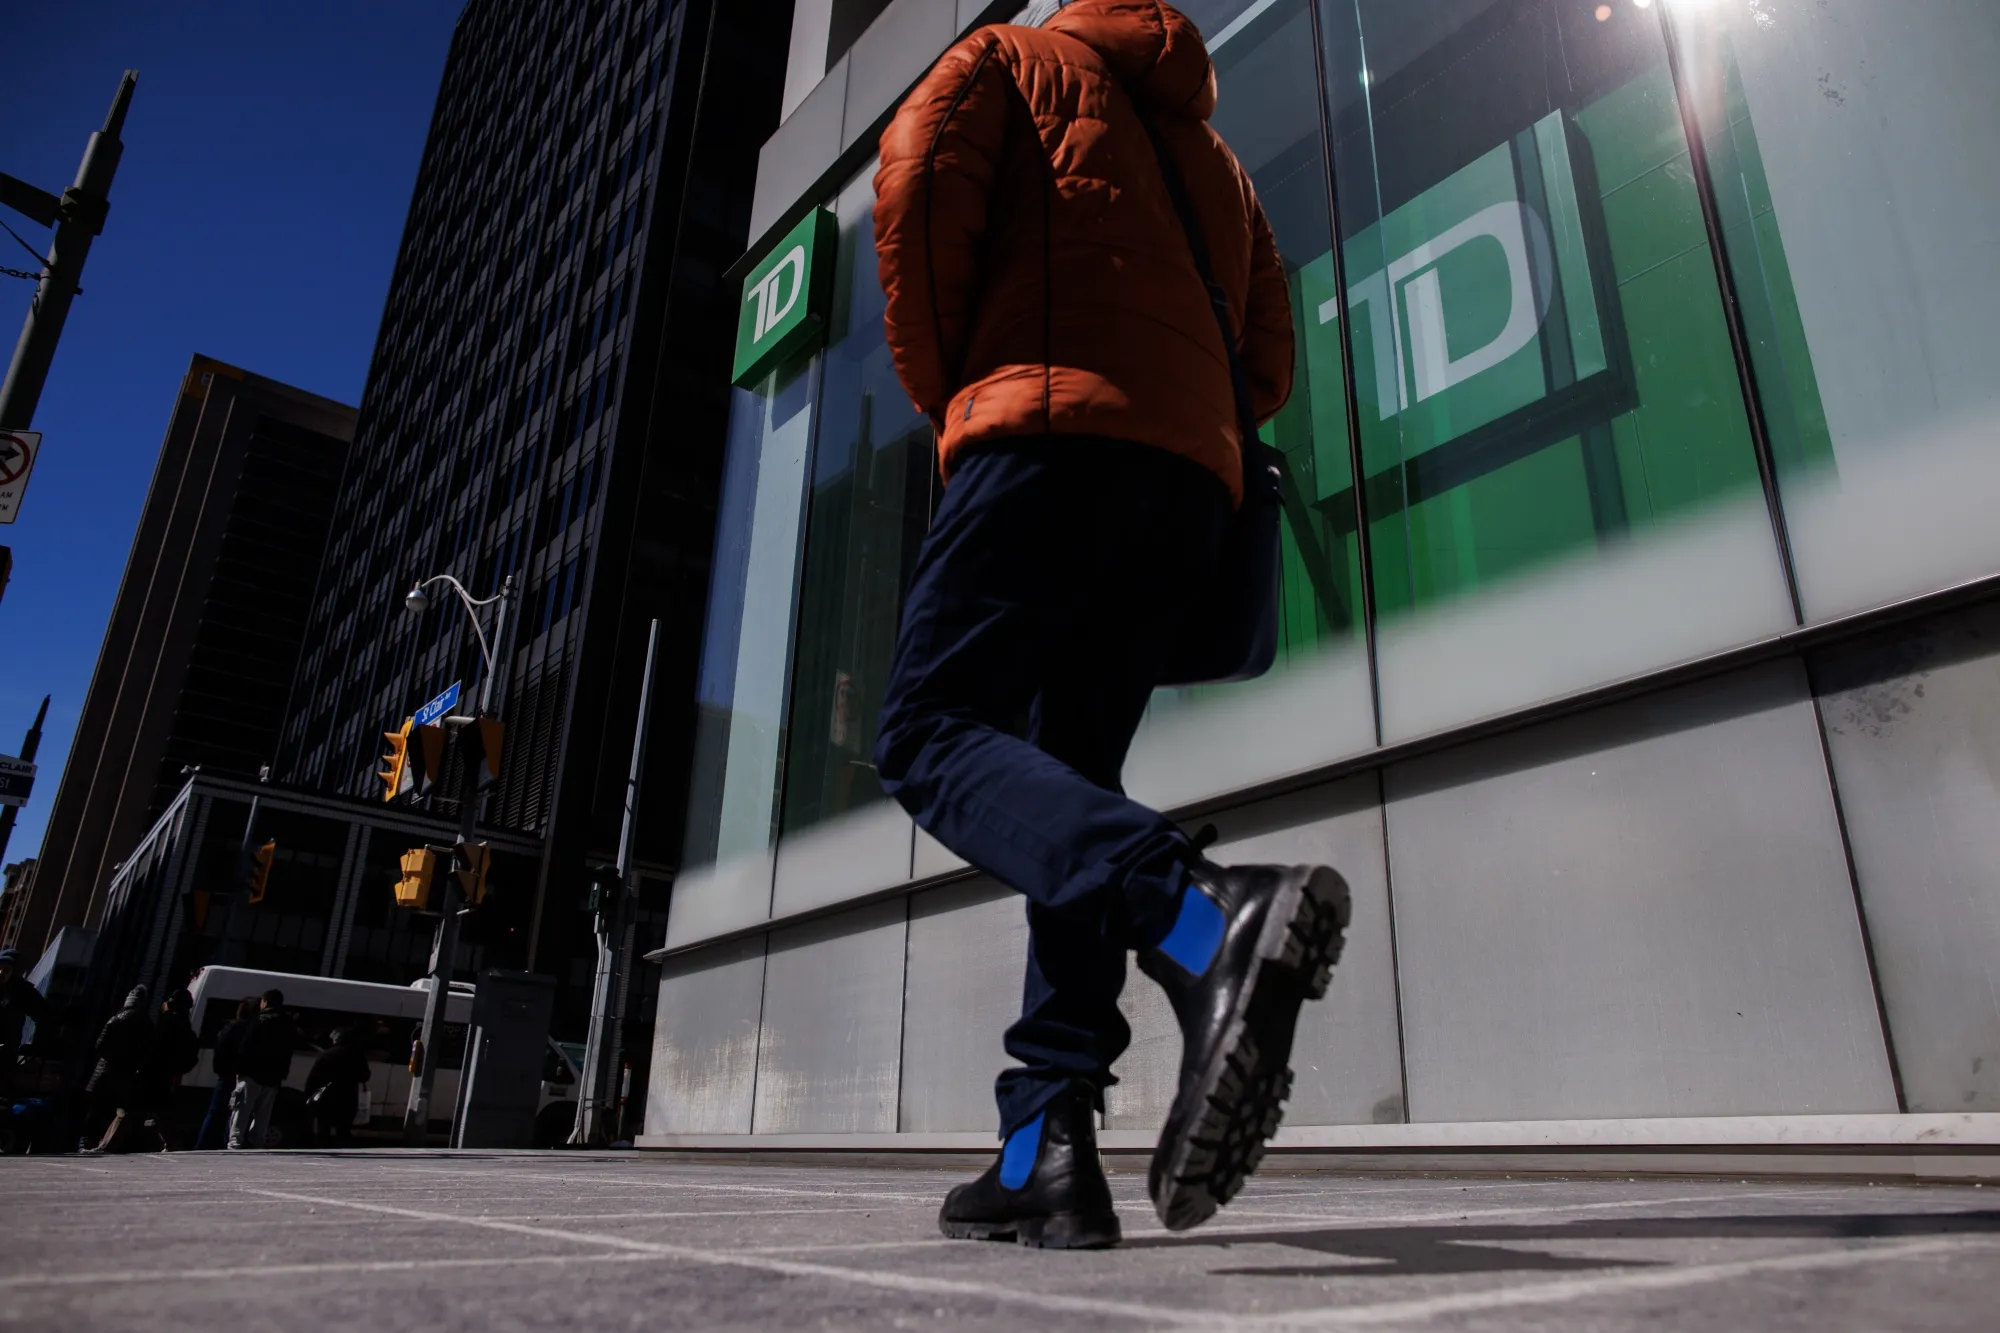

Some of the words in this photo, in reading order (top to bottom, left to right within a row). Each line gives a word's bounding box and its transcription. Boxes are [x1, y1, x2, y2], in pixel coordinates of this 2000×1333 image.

[747, 244, 805, 345] TD
[1318, 200, 1554, 422] TD
[0, 761, 32, 774] CLAIR
